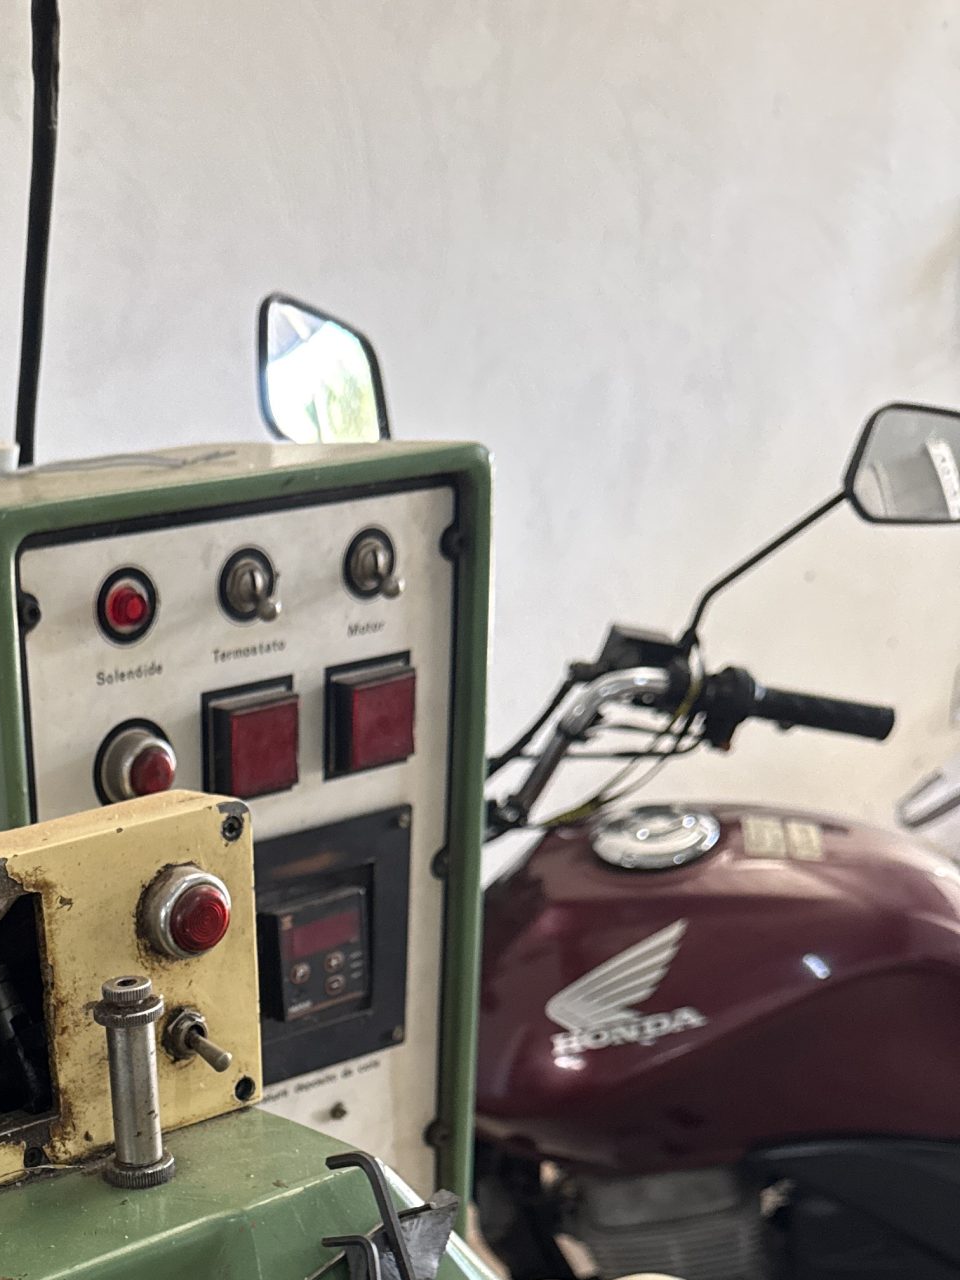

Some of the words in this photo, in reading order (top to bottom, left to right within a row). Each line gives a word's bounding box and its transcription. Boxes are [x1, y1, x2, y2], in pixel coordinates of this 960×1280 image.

[347, 621, 385, 638] Motor
[212, 638, 287, 664] Termostato
[550, 1006, 709, 1058] HONDA
